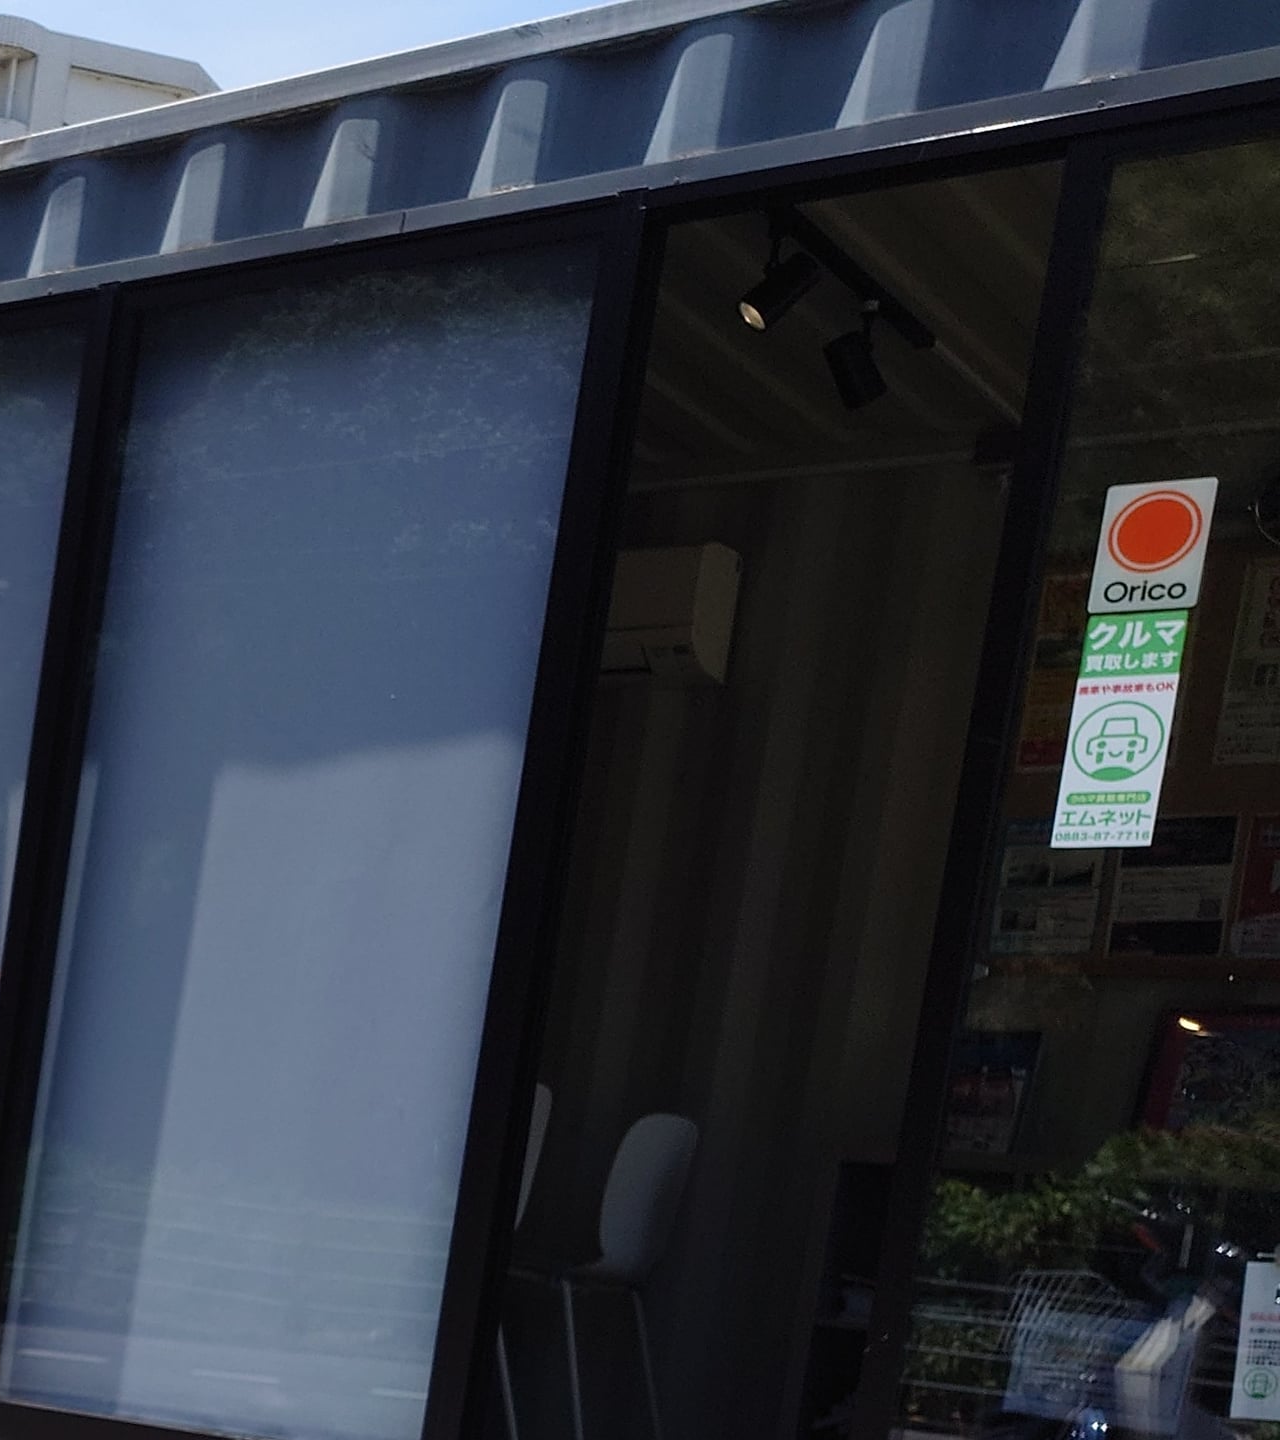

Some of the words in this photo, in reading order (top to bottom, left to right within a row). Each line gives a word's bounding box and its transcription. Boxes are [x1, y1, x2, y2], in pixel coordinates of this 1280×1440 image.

[1103, 580, 1187, 604] Orico
[1088, 620, 1186, 650] クルマ
[1085, 651, 1179, 672] 買取します
[1058, 809, 1152, 828] エムネット
